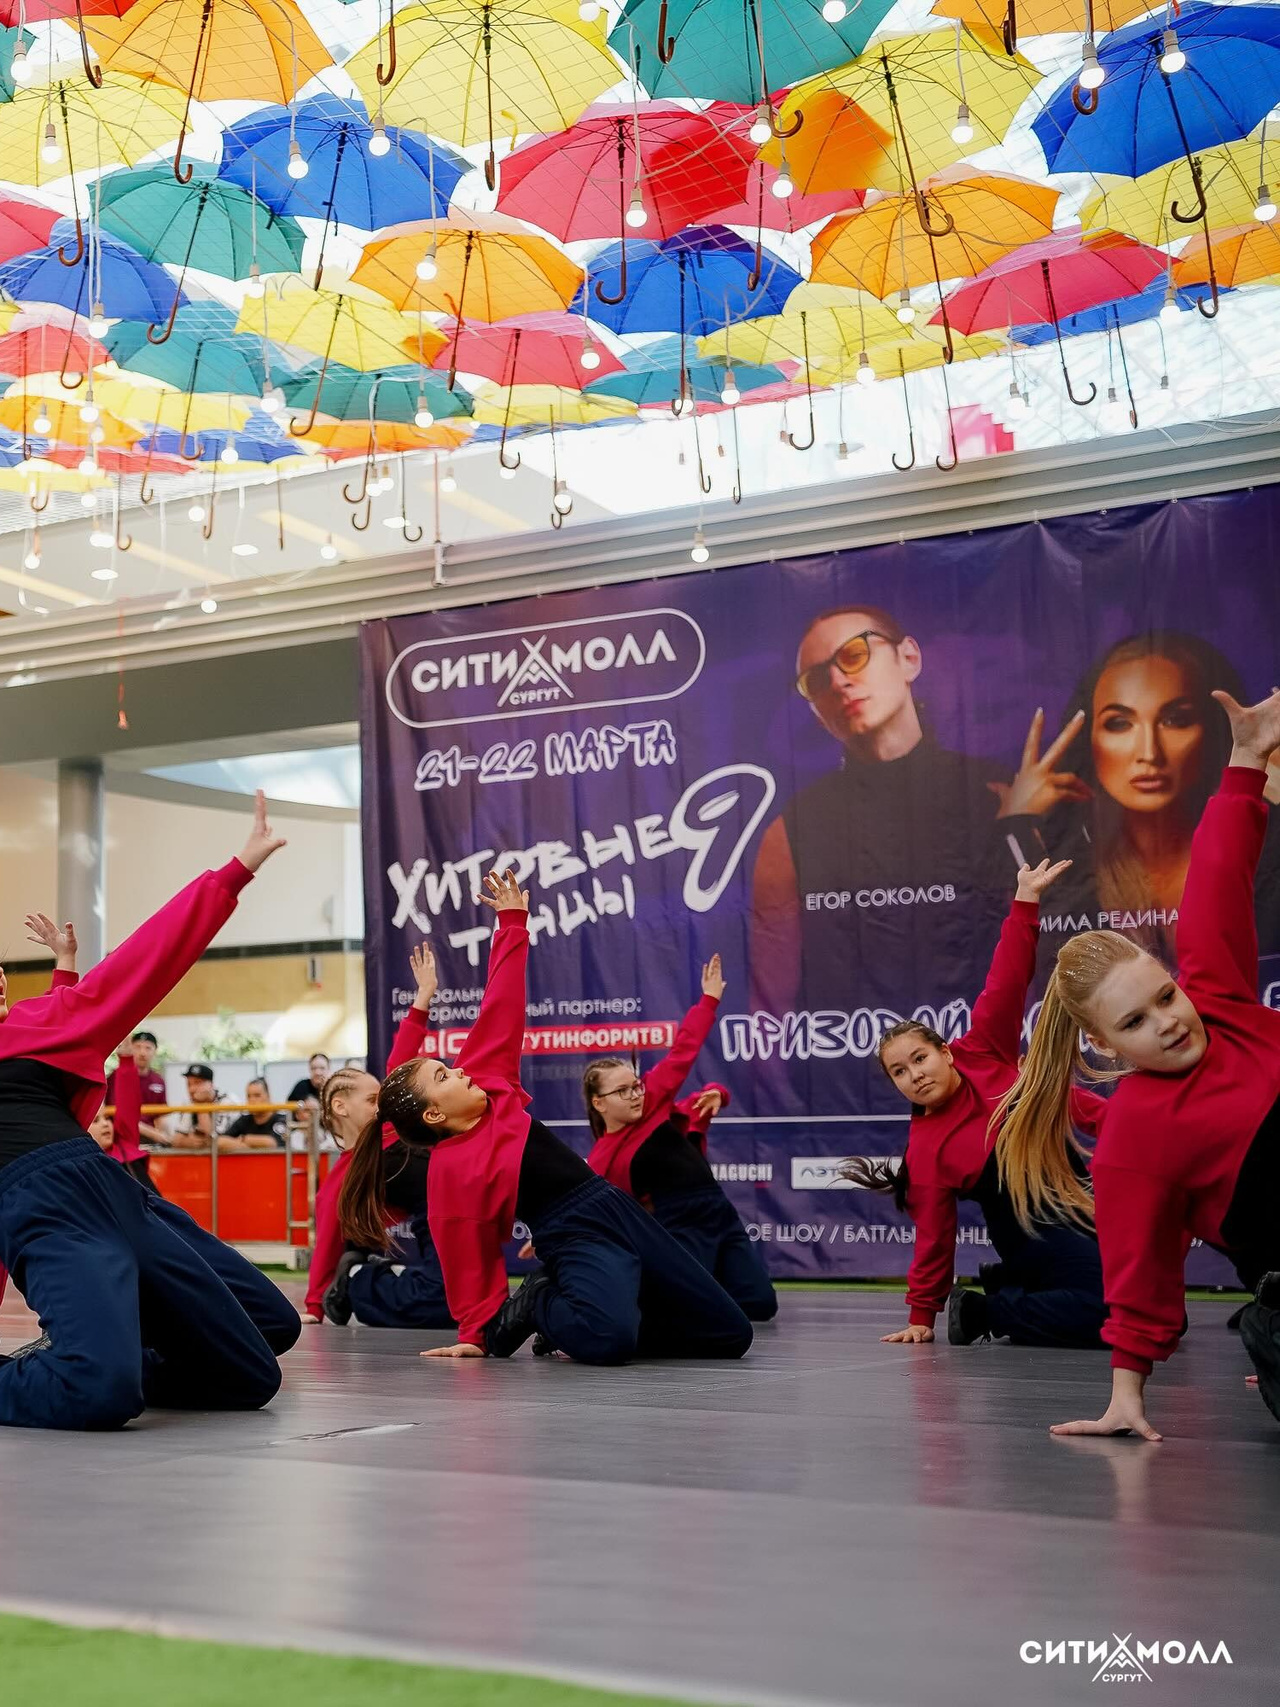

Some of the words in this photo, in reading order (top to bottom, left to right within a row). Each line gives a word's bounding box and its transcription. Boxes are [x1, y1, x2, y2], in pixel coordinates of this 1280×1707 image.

[410, 647, 519, 693] СИТИ
[551, 628, 677, 674] МОЛЛ
[509, 686, 561, 706] СУРГУТ
[413, 740, 538, 792] 21-22
[544, 719, 677, 777] МАРТА
[805, 891, 852, 911] ЕГОР
[855, 884, 956, 908] СОКОЛОВ
[448, 874, 636, 967] ТНЦЫ
[1097, 907, 1179, 930] РЕДИНА
[557, 996, 643, 1018] партнер:
[776, 1224, 825, 1243] ШОУ
